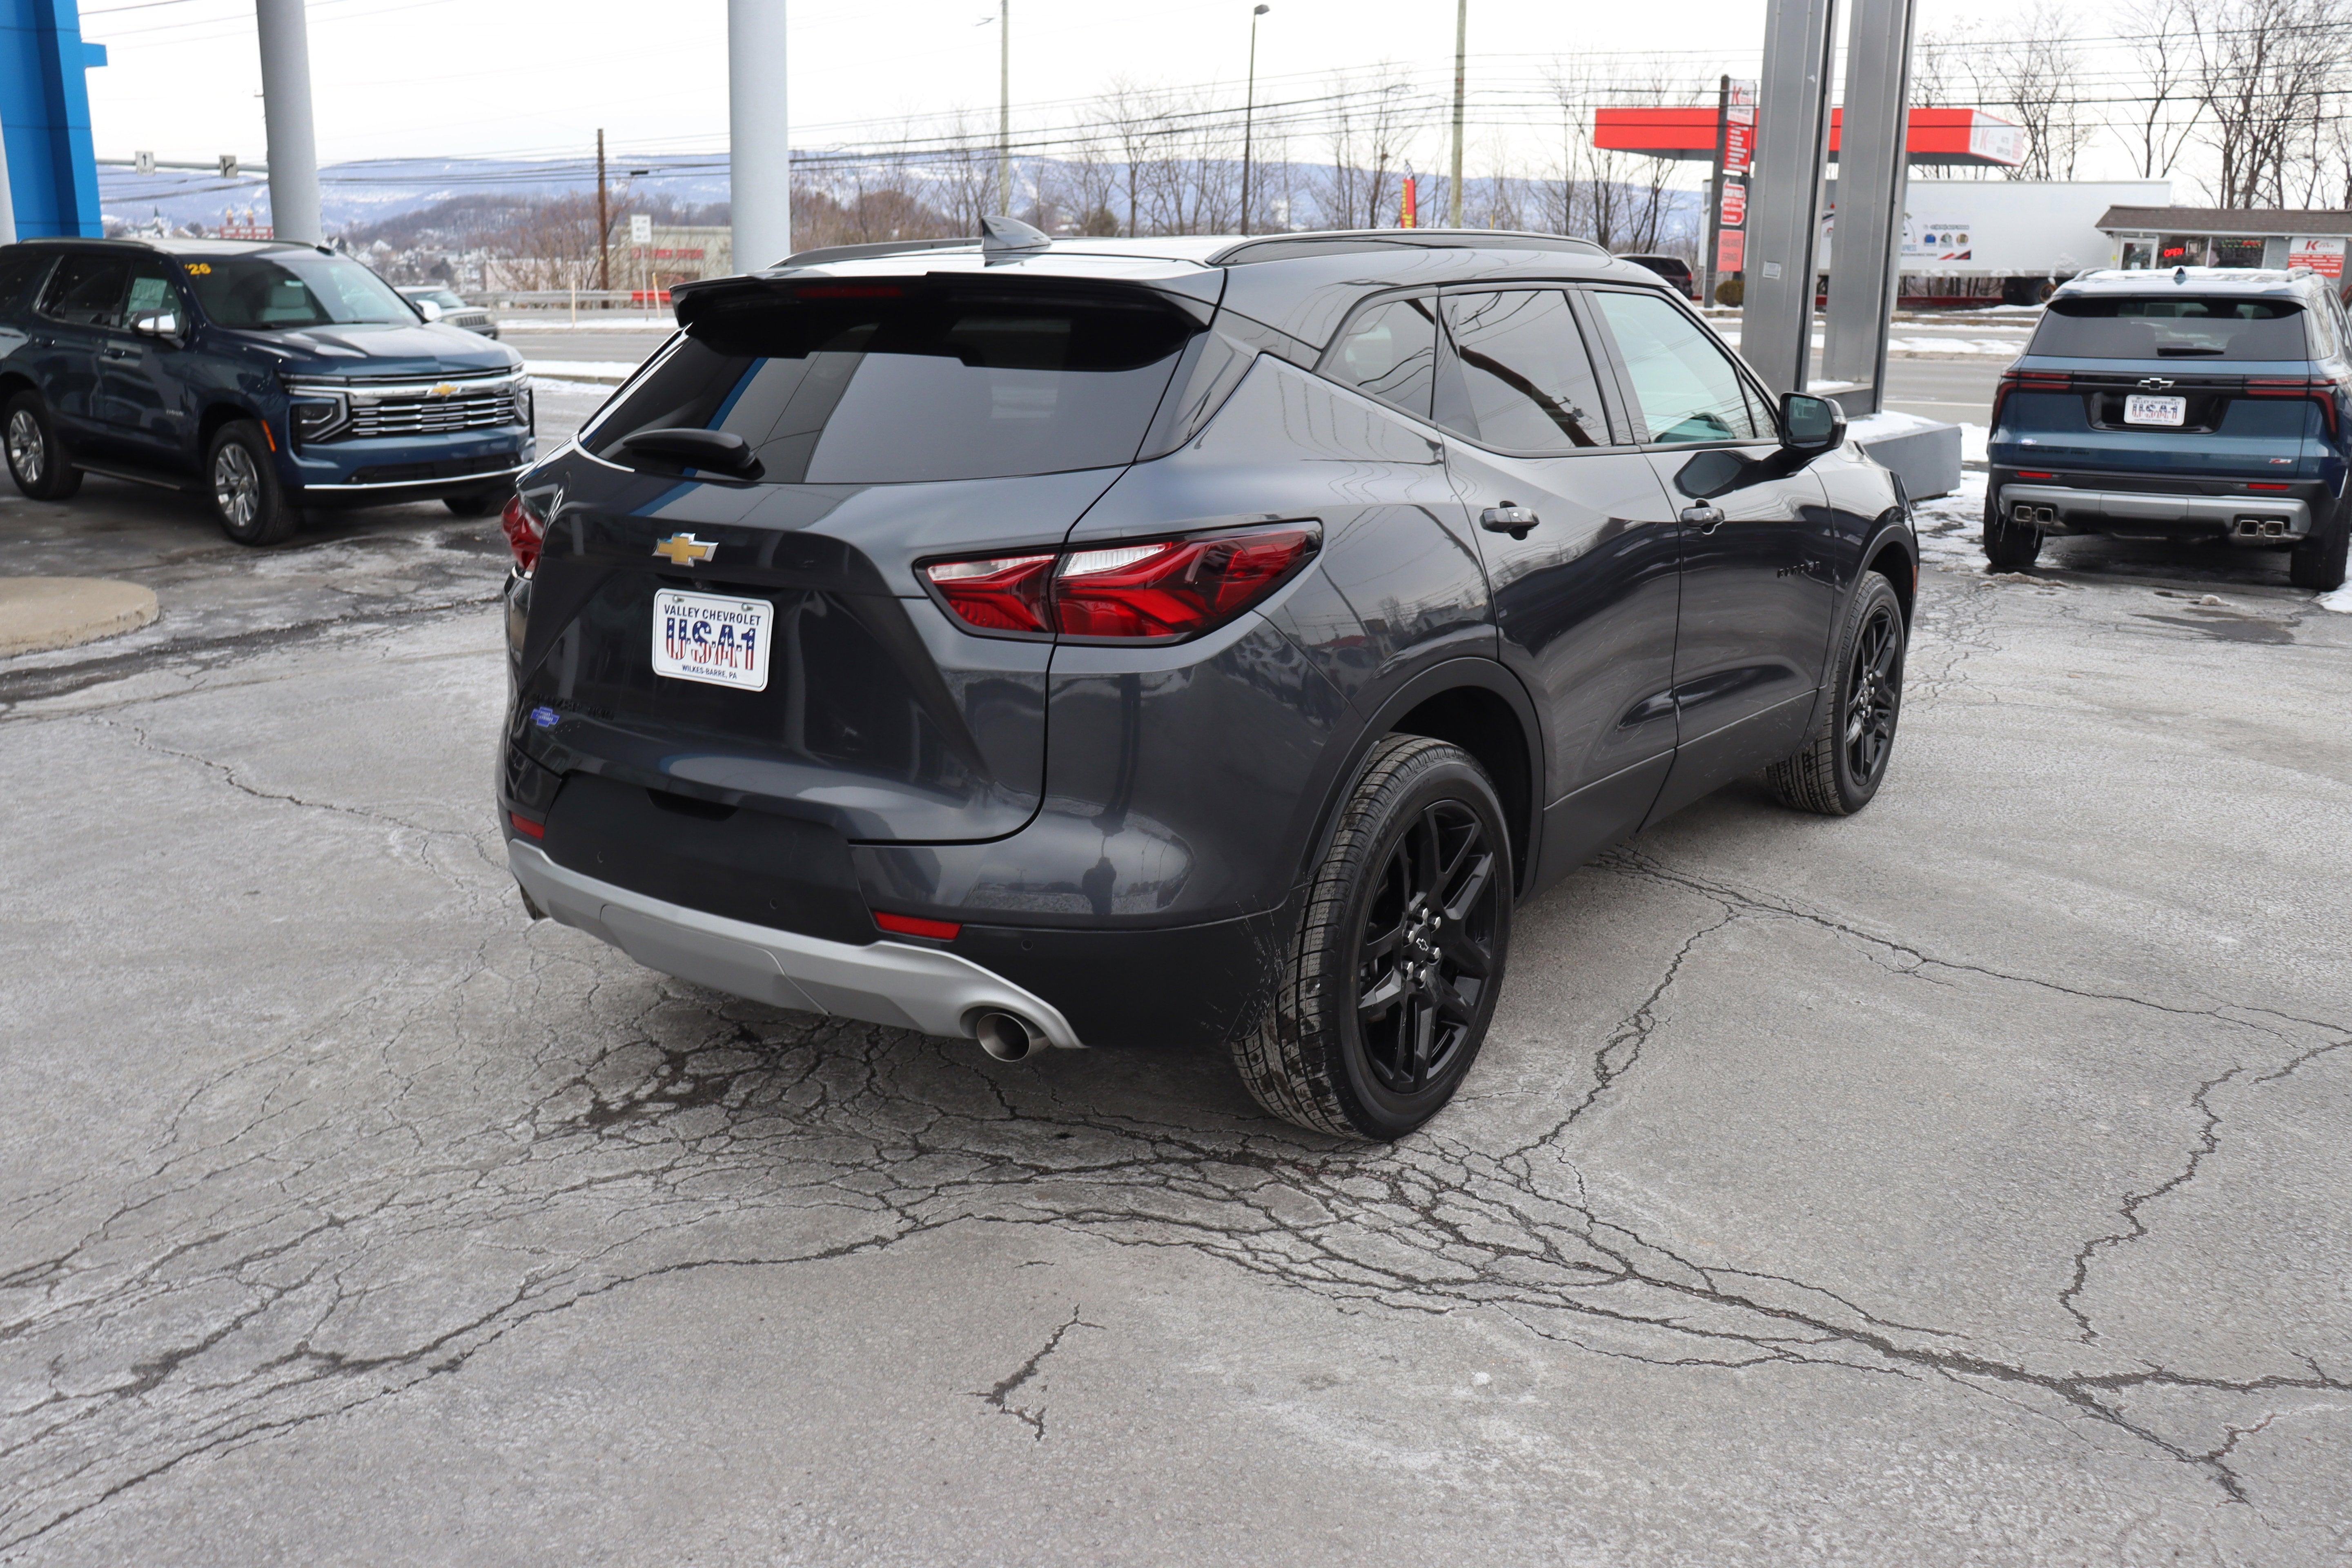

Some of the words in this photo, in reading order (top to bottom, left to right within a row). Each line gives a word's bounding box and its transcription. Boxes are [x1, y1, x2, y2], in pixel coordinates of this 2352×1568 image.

[2163, 247, 2184, 257] OPEN
[664, 604, 700, 618] VALLEY
[702, 609, 761, 626] CHEVROLET
[682, 664, 728, 679] WILKES-BARRE,
